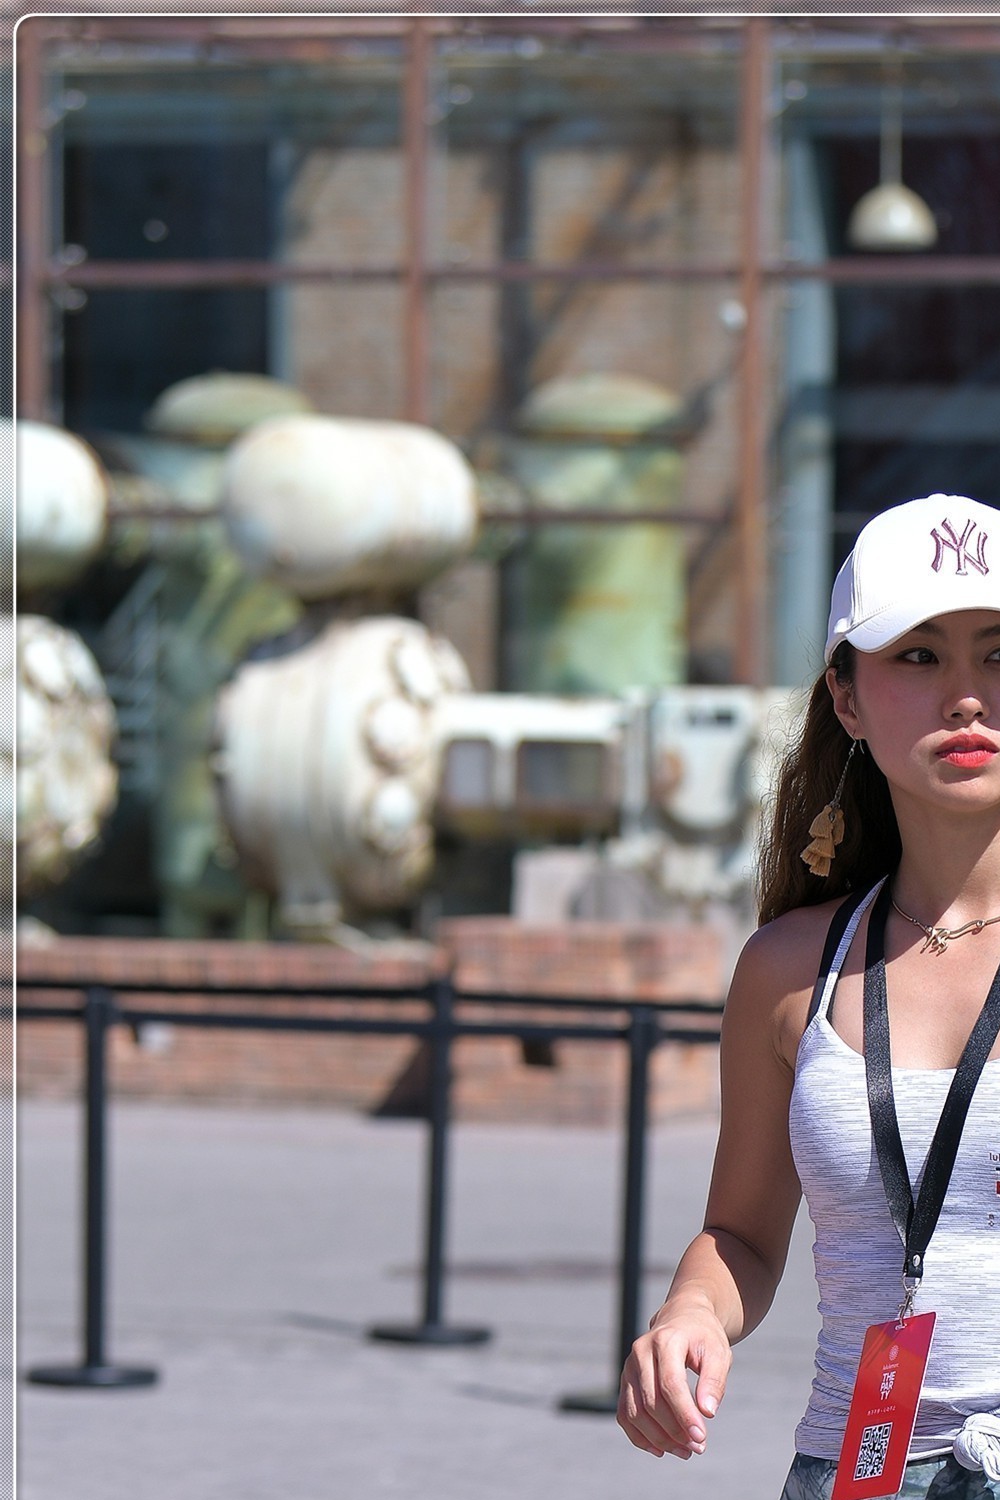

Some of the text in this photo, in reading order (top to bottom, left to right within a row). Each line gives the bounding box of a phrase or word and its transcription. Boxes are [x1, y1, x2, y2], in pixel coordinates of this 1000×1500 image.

[882, 1370, 897, 1382] THE
[879, 1380, 894, 1392] PAR
[880, 1389, 891, 1401] TY
